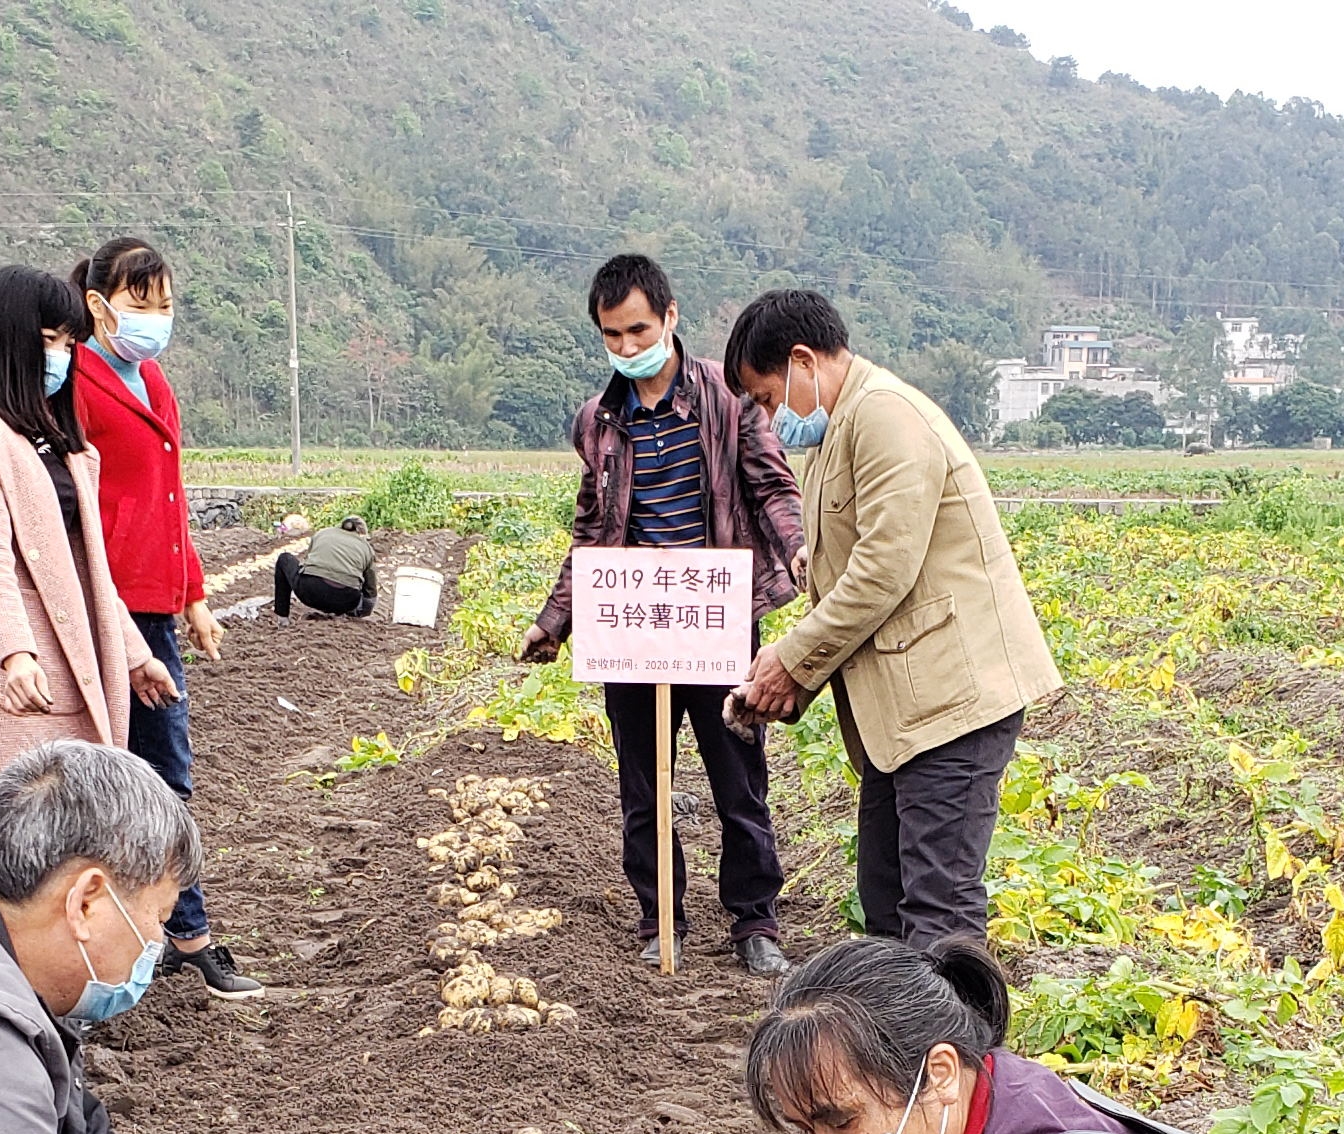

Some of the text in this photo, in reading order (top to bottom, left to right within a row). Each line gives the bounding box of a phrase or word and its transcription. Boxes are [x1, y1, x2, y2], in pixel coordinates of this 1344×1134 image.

[596, 603, 726, 630] 马铃薯项目
